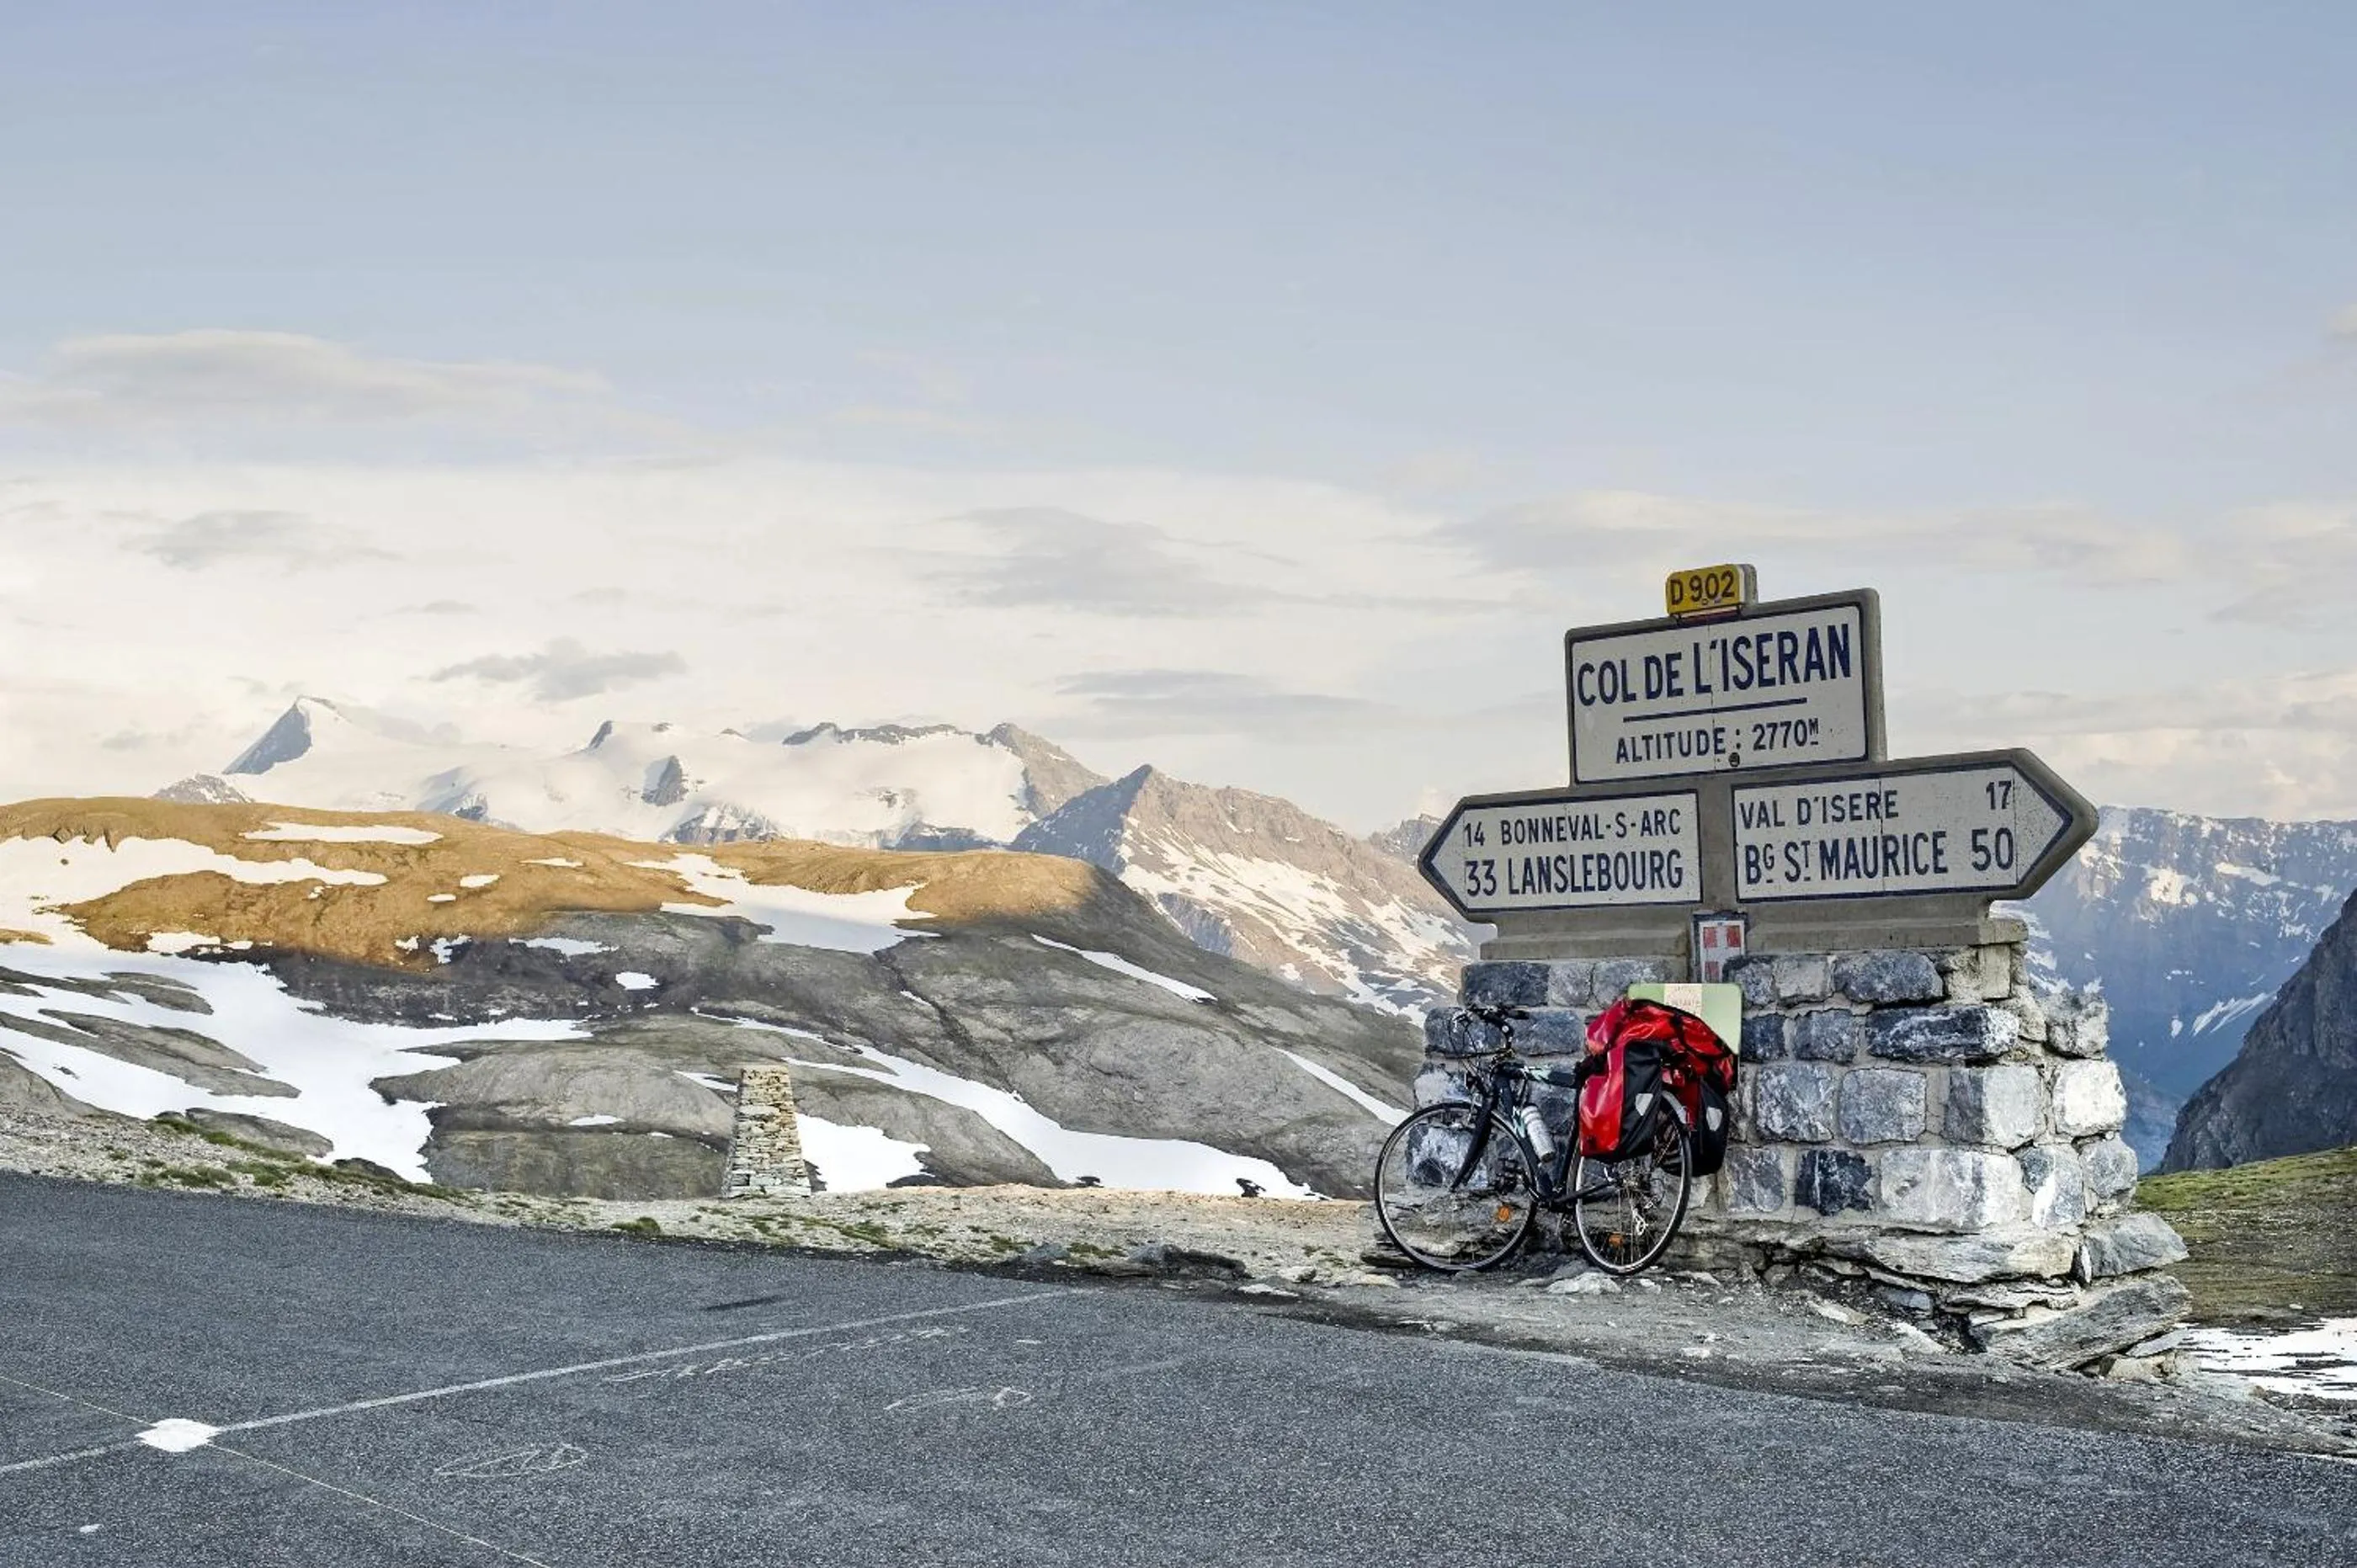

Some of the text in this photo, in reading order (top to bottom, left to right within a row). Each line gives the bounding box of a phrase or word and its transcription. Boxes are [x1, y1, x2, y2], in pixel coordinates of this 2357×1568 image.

[1670, 569, 1735, 605] D 902
[1577, 624, 1850, 707] COL DE L'ISERAN
[1739, 780, 2013, 831] VAL D'ISERE 17
[1463, 821, 1486, 848] 14
[1819, 830, 1949, 881] MAURICE
[1971, 827, 2014, 872] 50
[1465, 848, 1684, 897] 33 LANSLEBOURG
